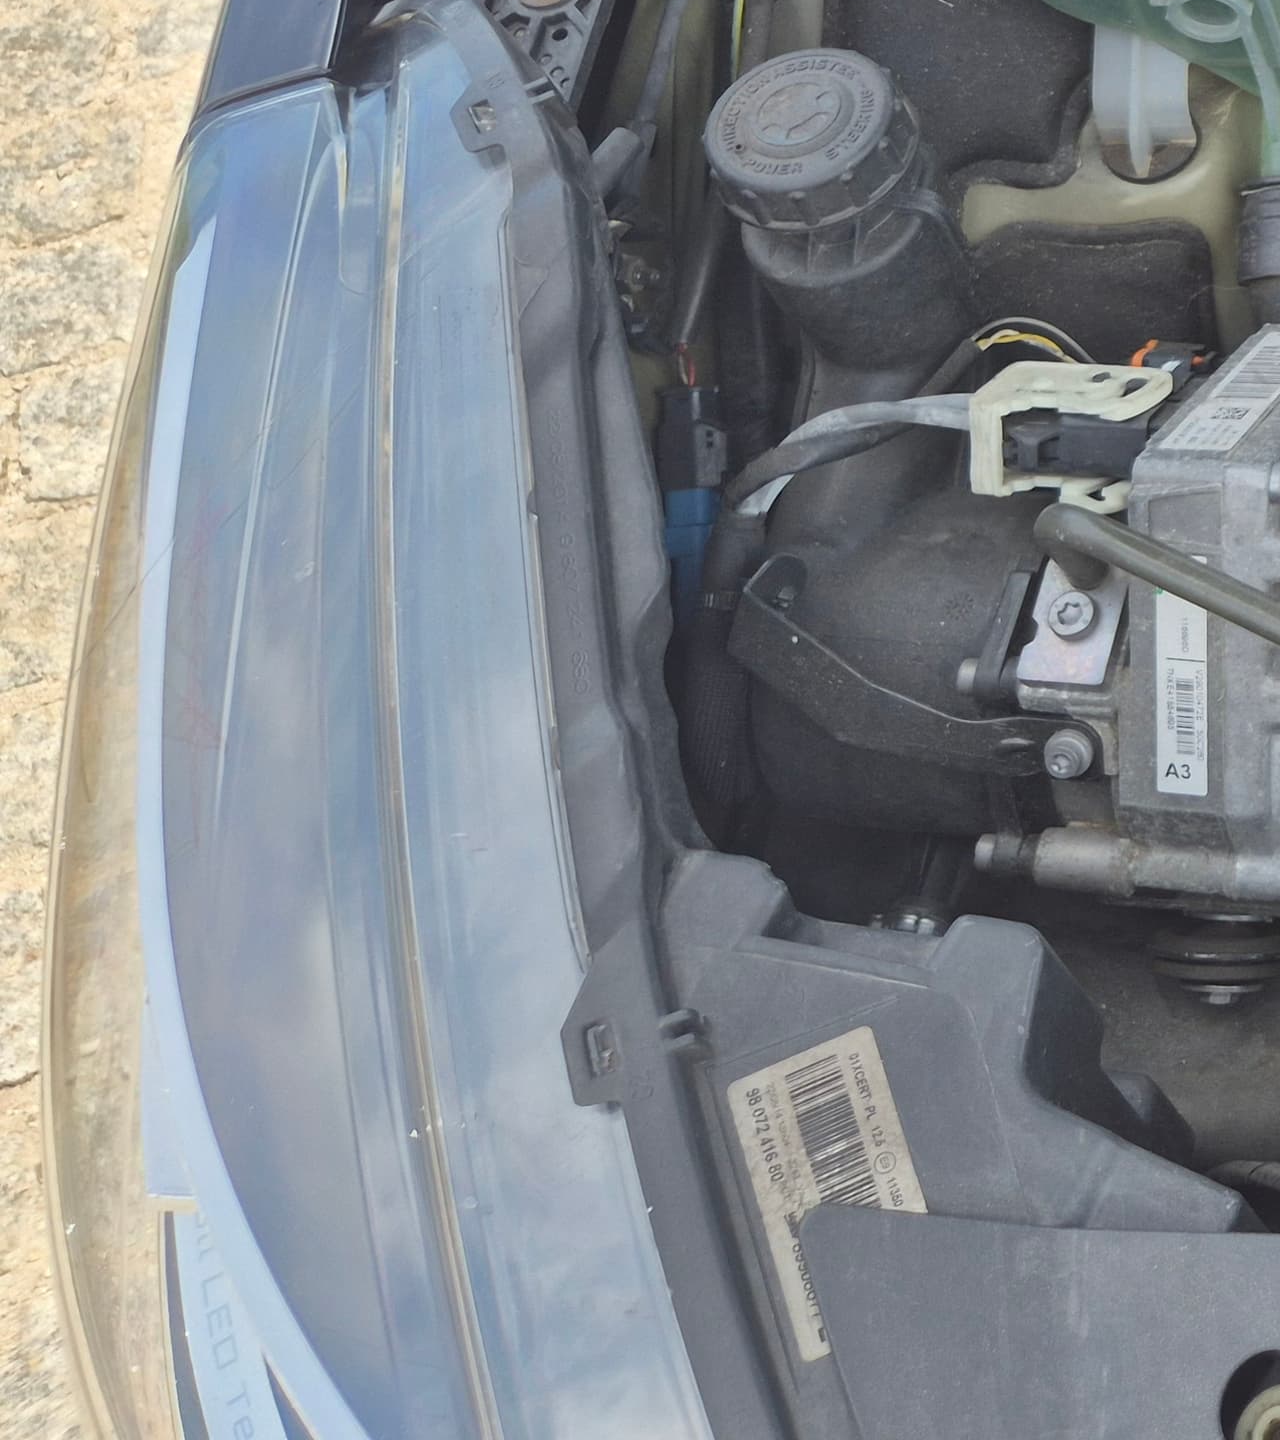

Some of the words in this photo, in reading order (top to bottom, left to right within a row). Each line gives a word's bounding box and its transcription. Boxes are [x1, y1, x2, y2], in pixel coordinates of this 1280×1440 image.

[1165, 762, 1192, 779] A3
[746, 1087, 763, 1107] 98
[752, 1107, 770, 1135] 072
[864, 1104, 878, 1121] PL
[759, 1136, 778, 1162] 416
[768, 1163, 785, 1182] 80
[202, 1272, 238, 1370] LED
